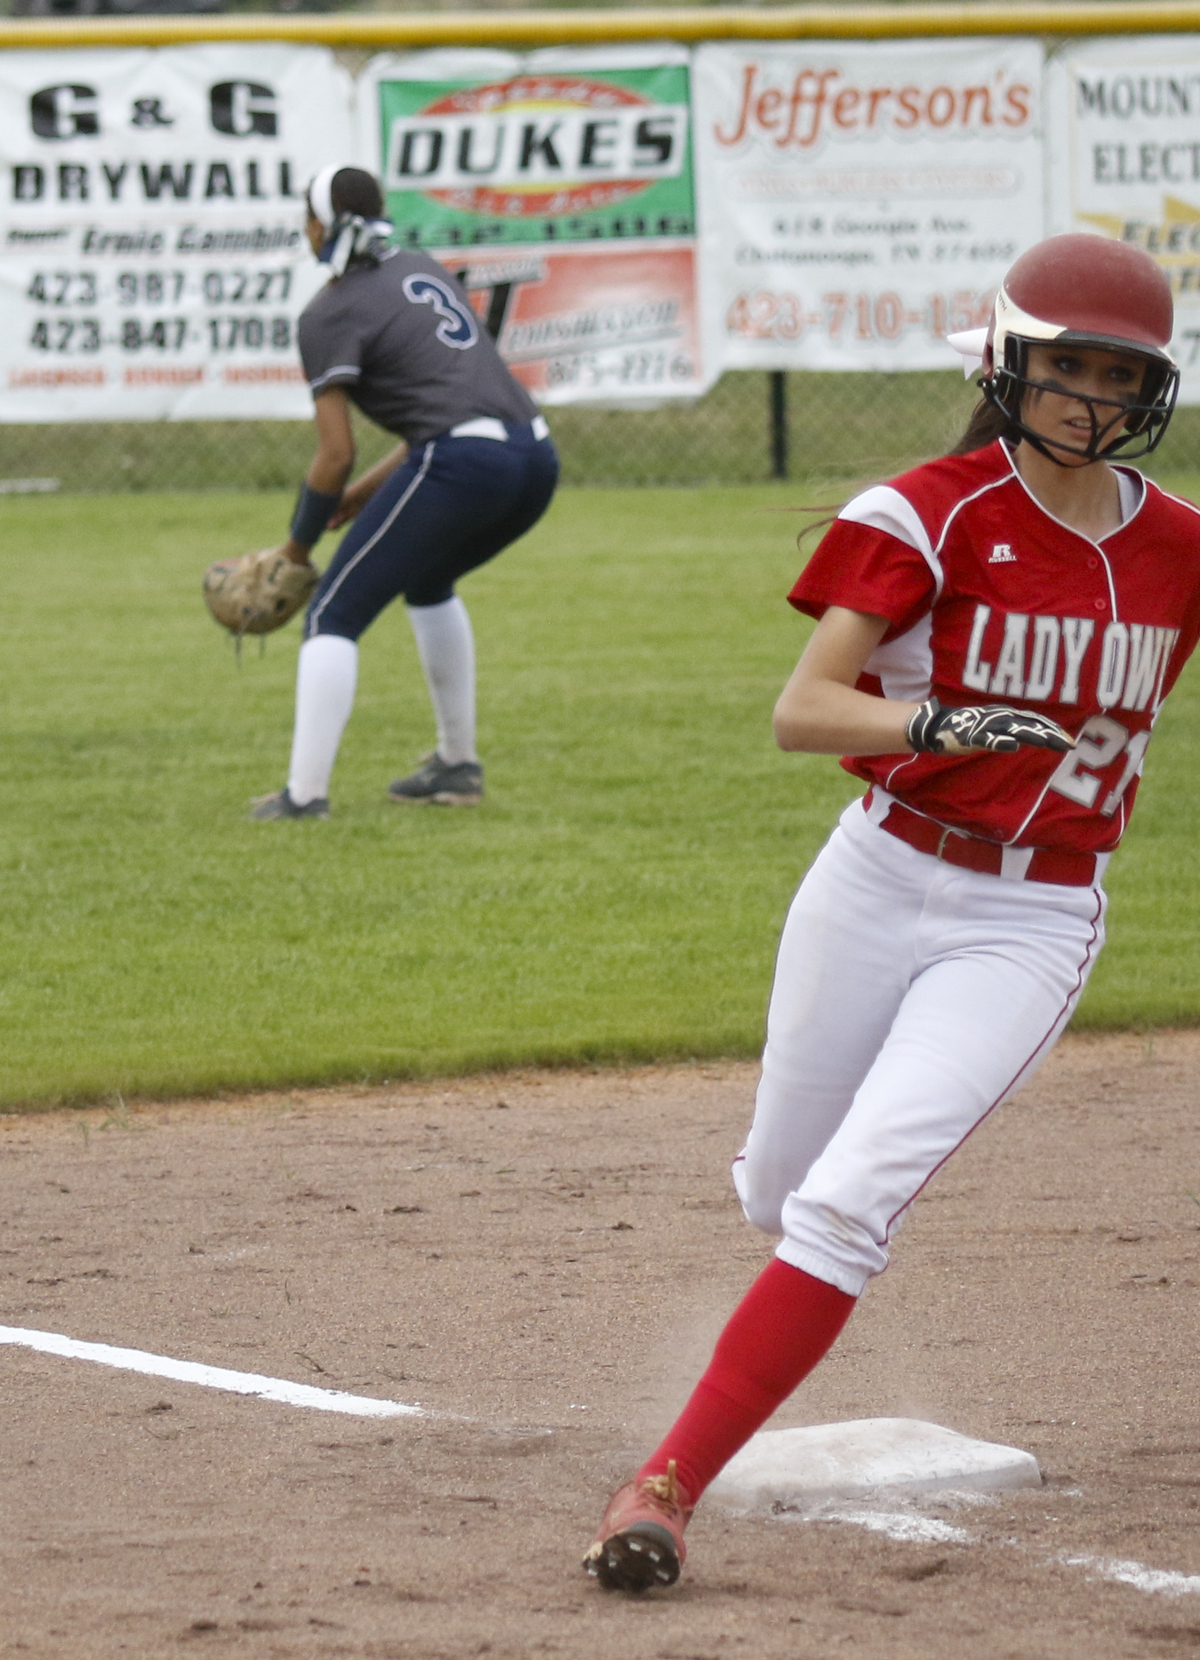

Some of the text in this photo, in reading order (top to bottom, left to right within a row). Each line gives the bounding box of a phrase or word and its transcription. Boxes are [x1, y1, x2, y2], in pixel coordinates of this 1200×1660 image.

[31, 80, 278, 139] G & G
[713, 63, 1031, 148] Jefferson's
[12, 160, 300, 200] DRYWALL
[398, 117, 675, 177] DUKES
[402, 273, 478, 350] 3
[962, 603, 1095, 704] LADY
[1050, 713, 1150, 818] 21
